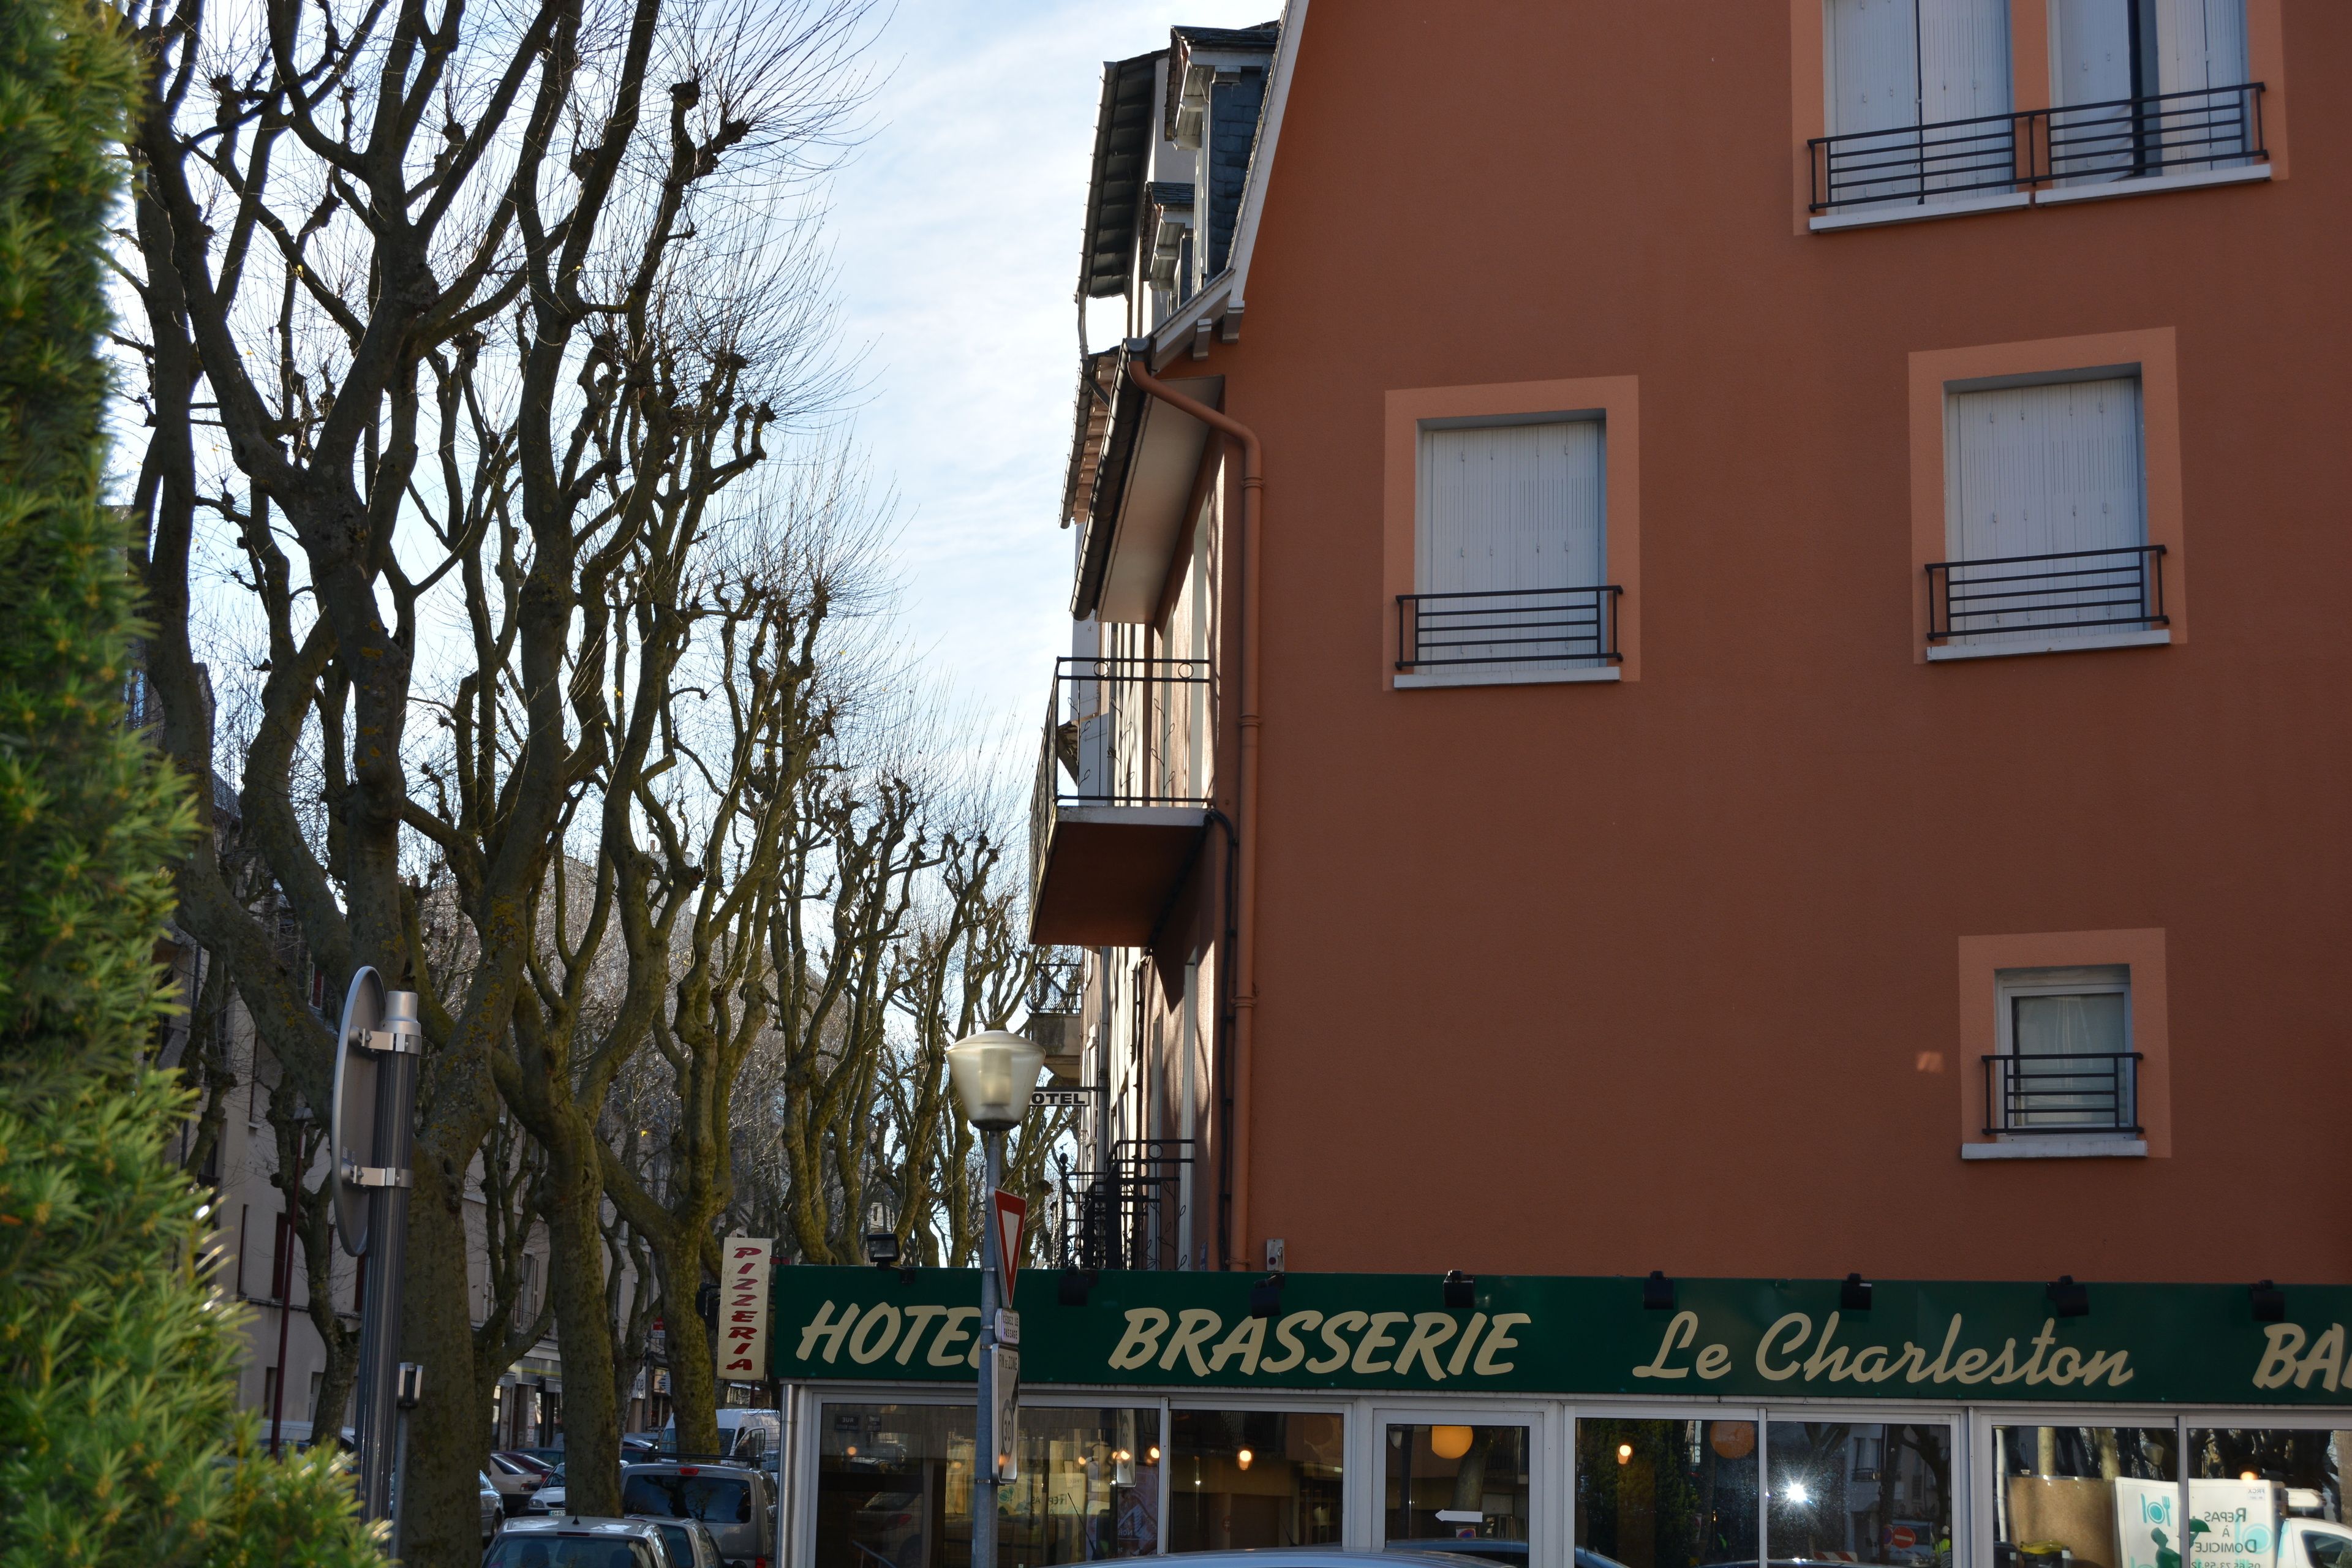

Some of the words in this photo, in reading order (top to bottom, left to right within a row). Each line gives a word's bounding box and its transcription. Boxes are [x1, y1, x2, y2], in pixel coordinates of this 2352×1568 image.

[1031, 1093, 1085, 1104] OTEL
[725, 1247, 762, 1371] PIZZERIA
[1003, 1313, 1014, 1325] CÉDEZ
[1014, 1317, 1019, 1327] LE
[1003, 1327, 1018, 1340] PASSAGE
[1107, 1308, 1531, 1381] BRASSERIE
[1632, 1311, 1731, 1379] Le
[1755, 1310, 2134, 1386] Charleston
[1008, 1355, 1017, 1371] ZONE
[1004, 1420, 1011, 1442] 30
